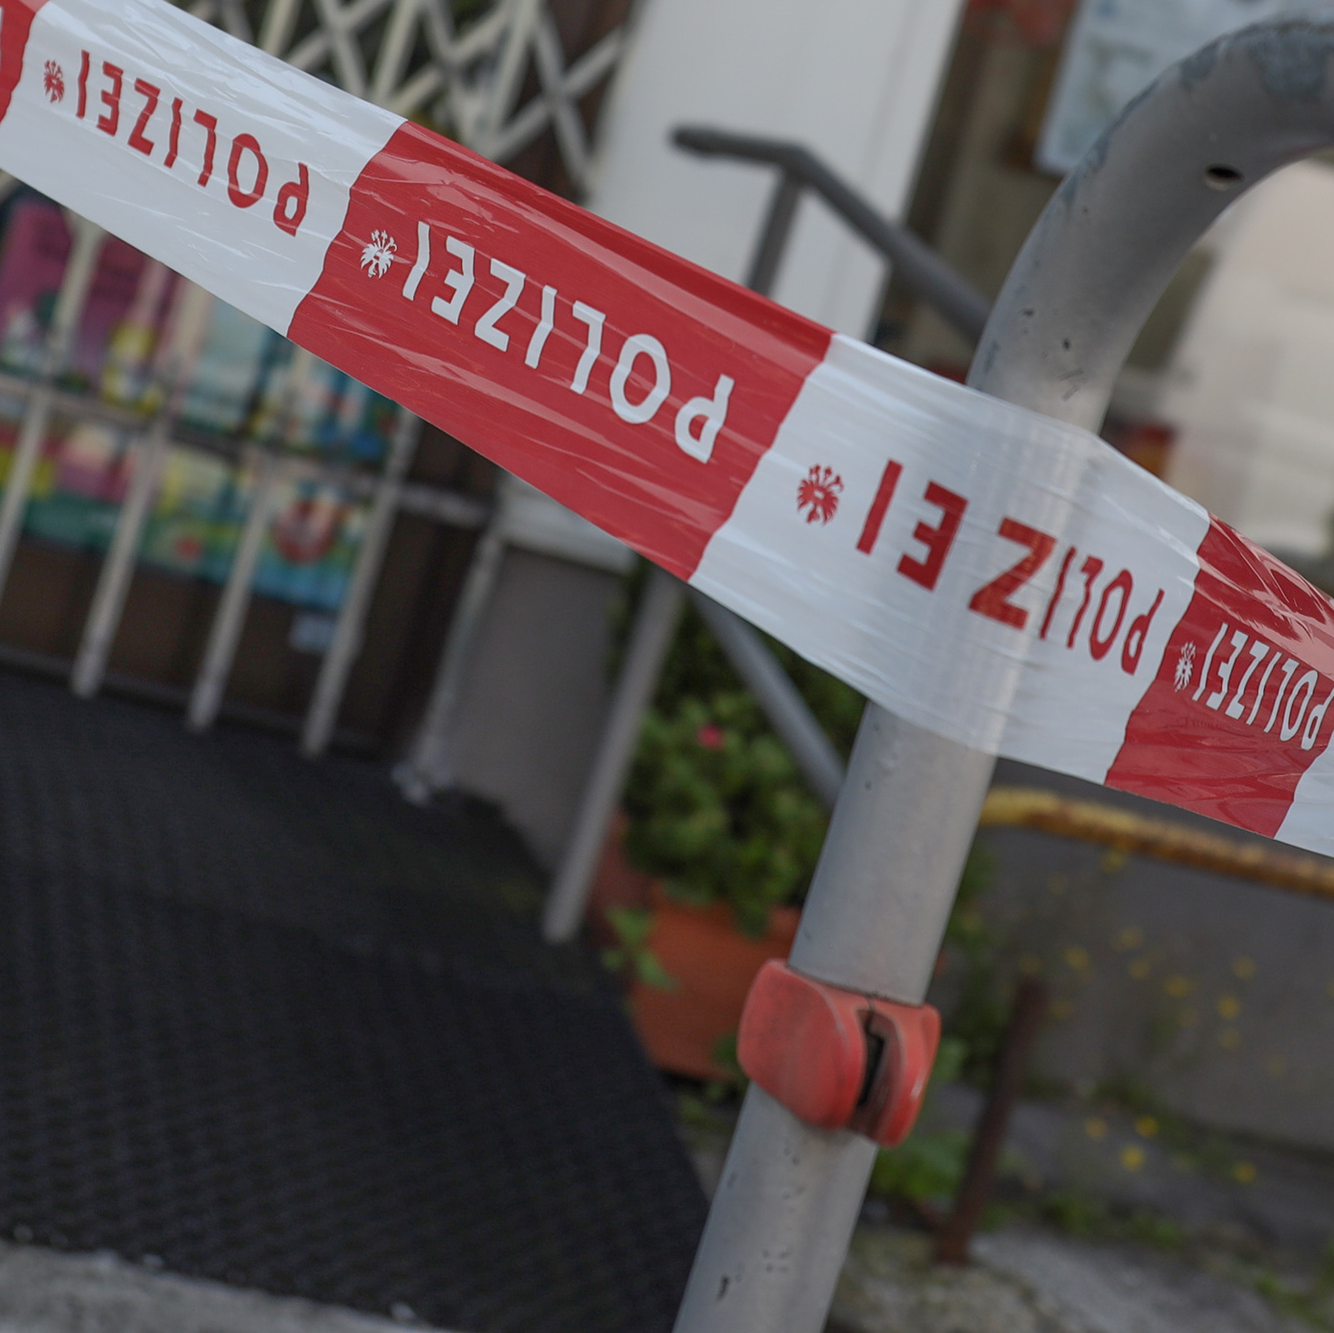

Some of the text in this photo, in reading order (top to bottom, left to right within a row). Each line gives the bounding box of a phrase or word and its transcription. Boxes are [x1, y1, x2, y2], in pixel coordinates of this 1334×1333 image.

[75, 49, 310, 238] POLIZEI
[402, 221, 735, 464] POLIZEI
[856, 459, 1166, 676] POLIZEI
